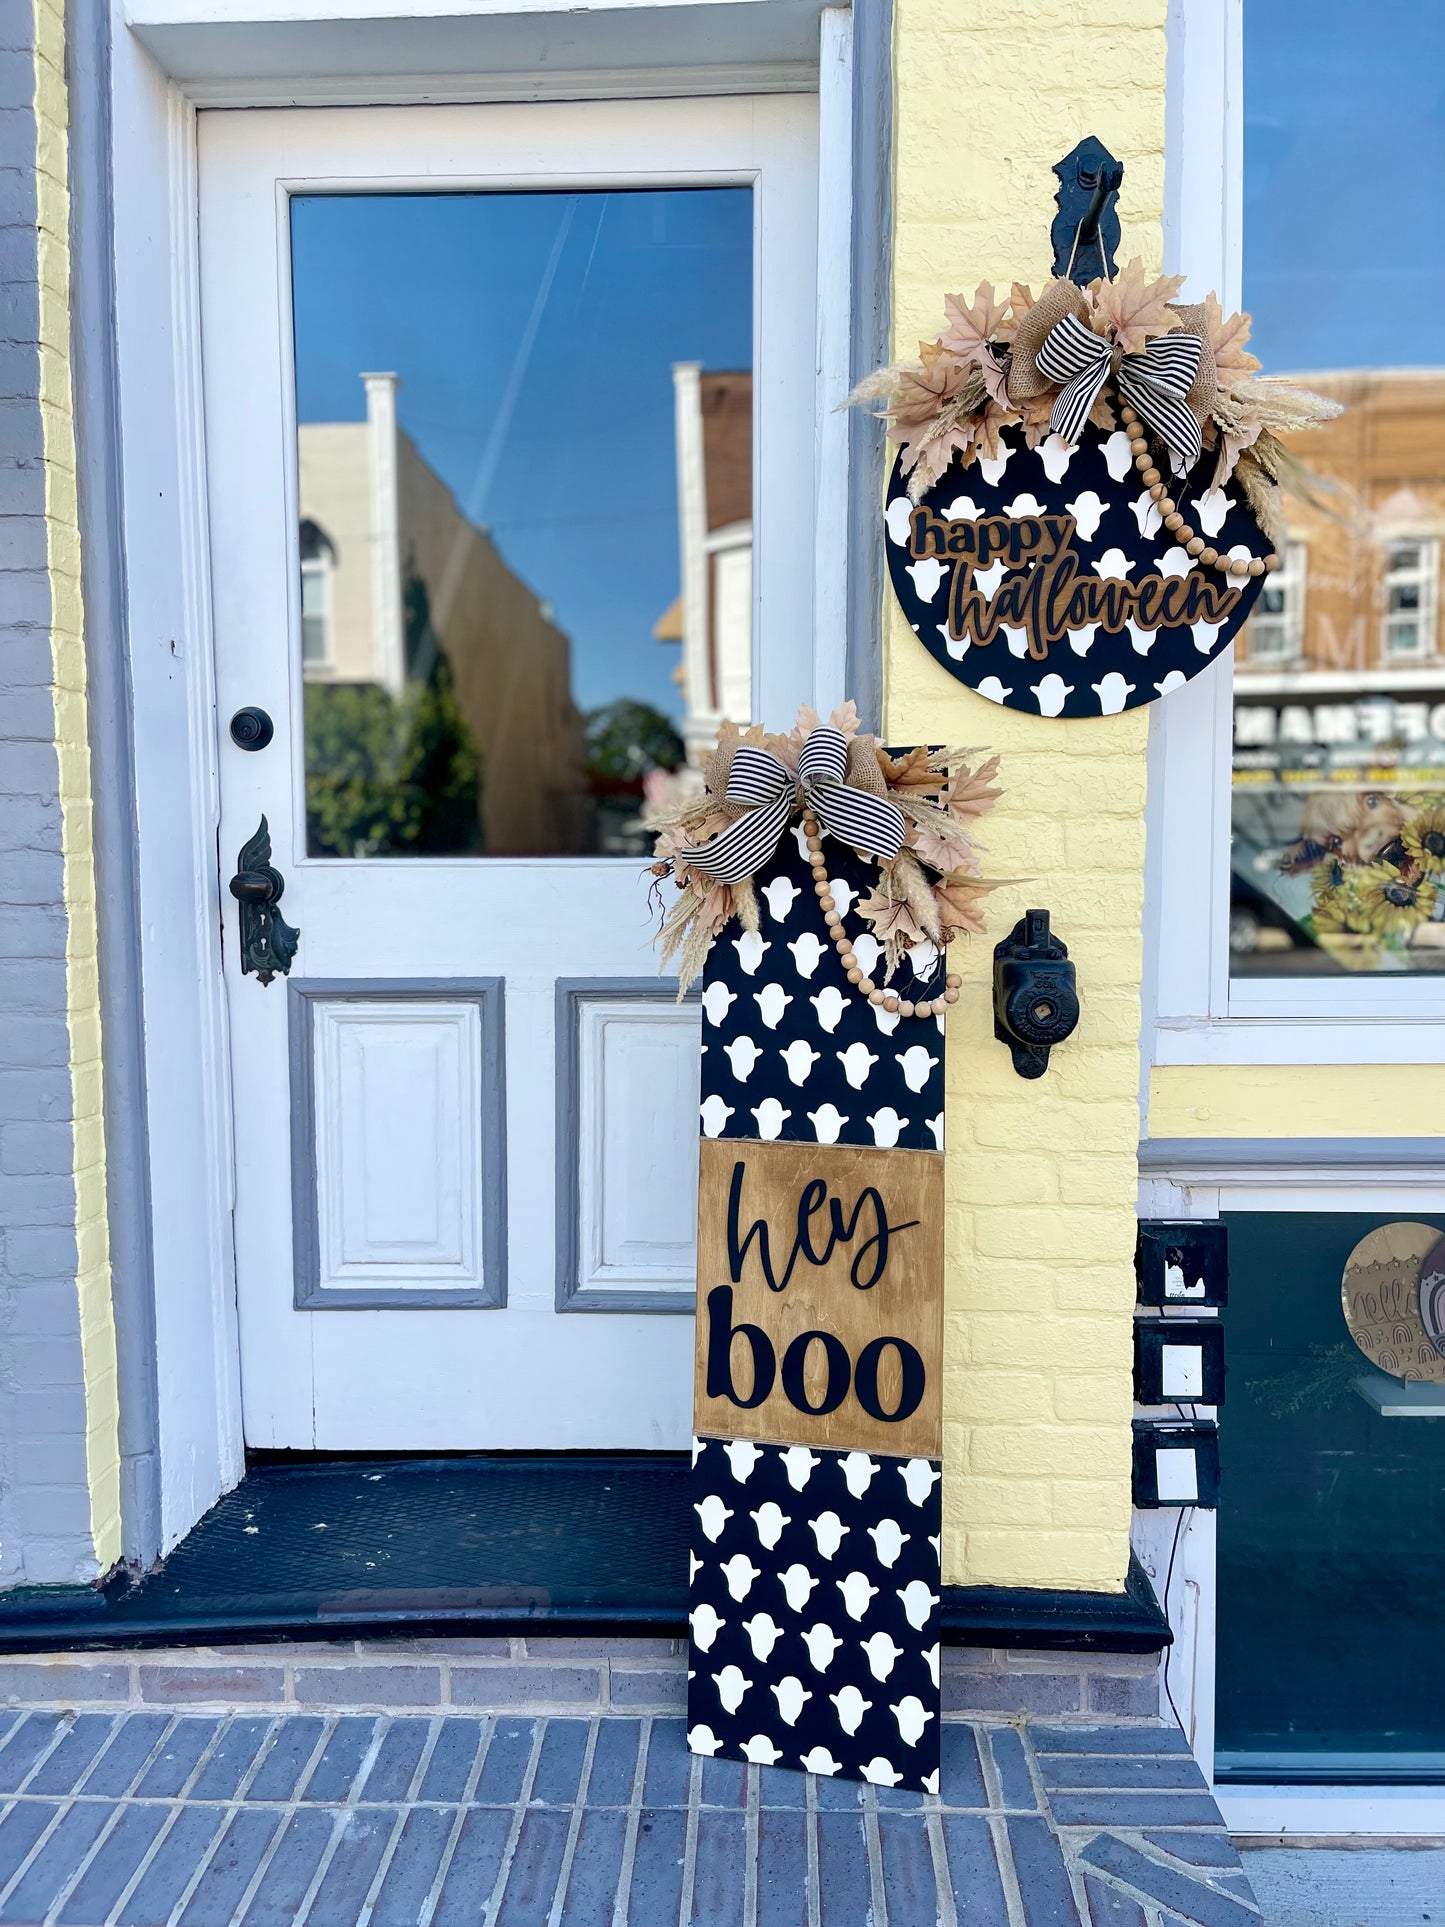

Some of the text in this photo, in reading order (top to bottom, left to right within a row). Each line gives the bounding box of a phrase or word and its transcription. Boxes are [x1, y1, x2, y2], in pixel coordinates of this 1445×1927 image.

[911, 508, 1075, 568] happy
[952, 555, 1238, 657] halloween
[727, 1161, 920, 1292] hey
[707, 1285, 926, 1422] boo
